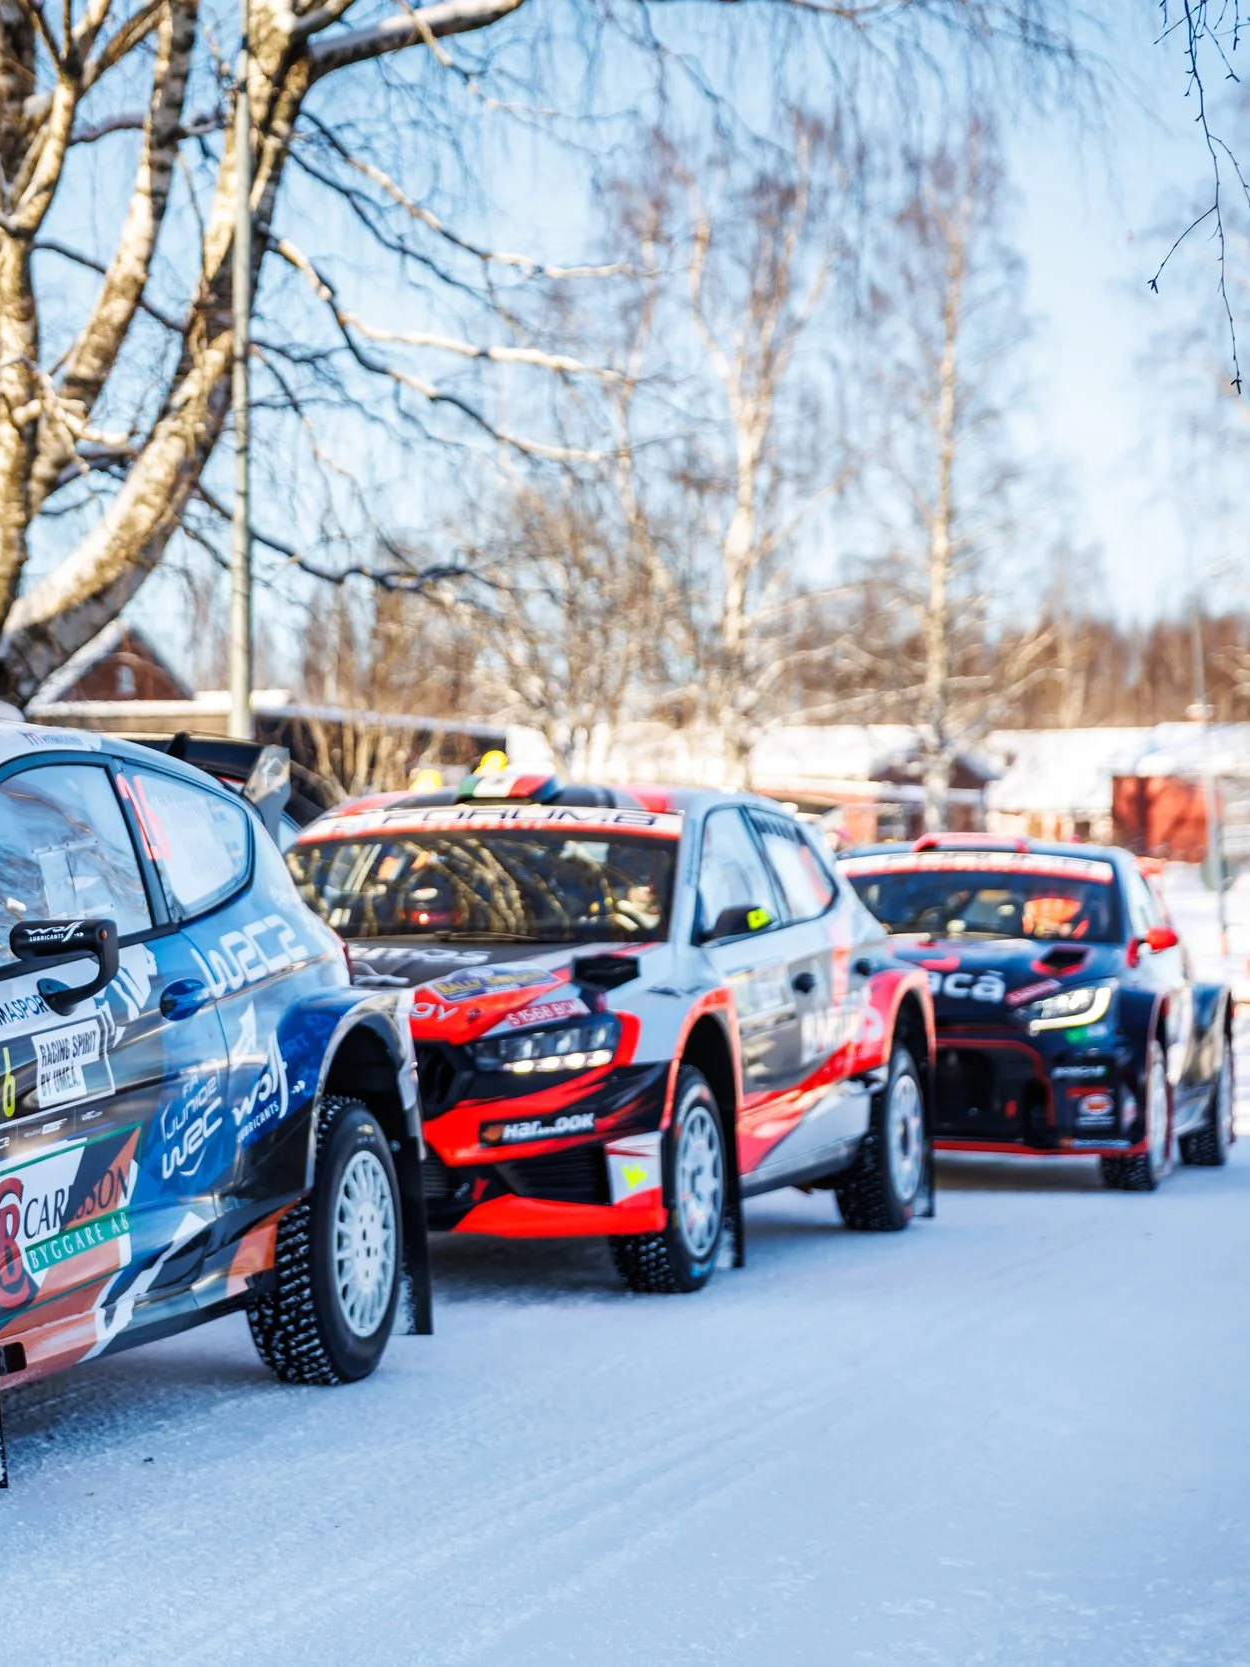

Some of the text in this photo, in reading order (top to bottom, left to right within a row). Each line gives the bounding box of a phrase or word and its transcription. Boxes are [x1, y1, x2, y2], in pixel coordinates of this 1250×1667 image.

[29, 933, 64, 942] LUBRICANTS
[29, 1212, 130, 1269] BYGGARE AB
